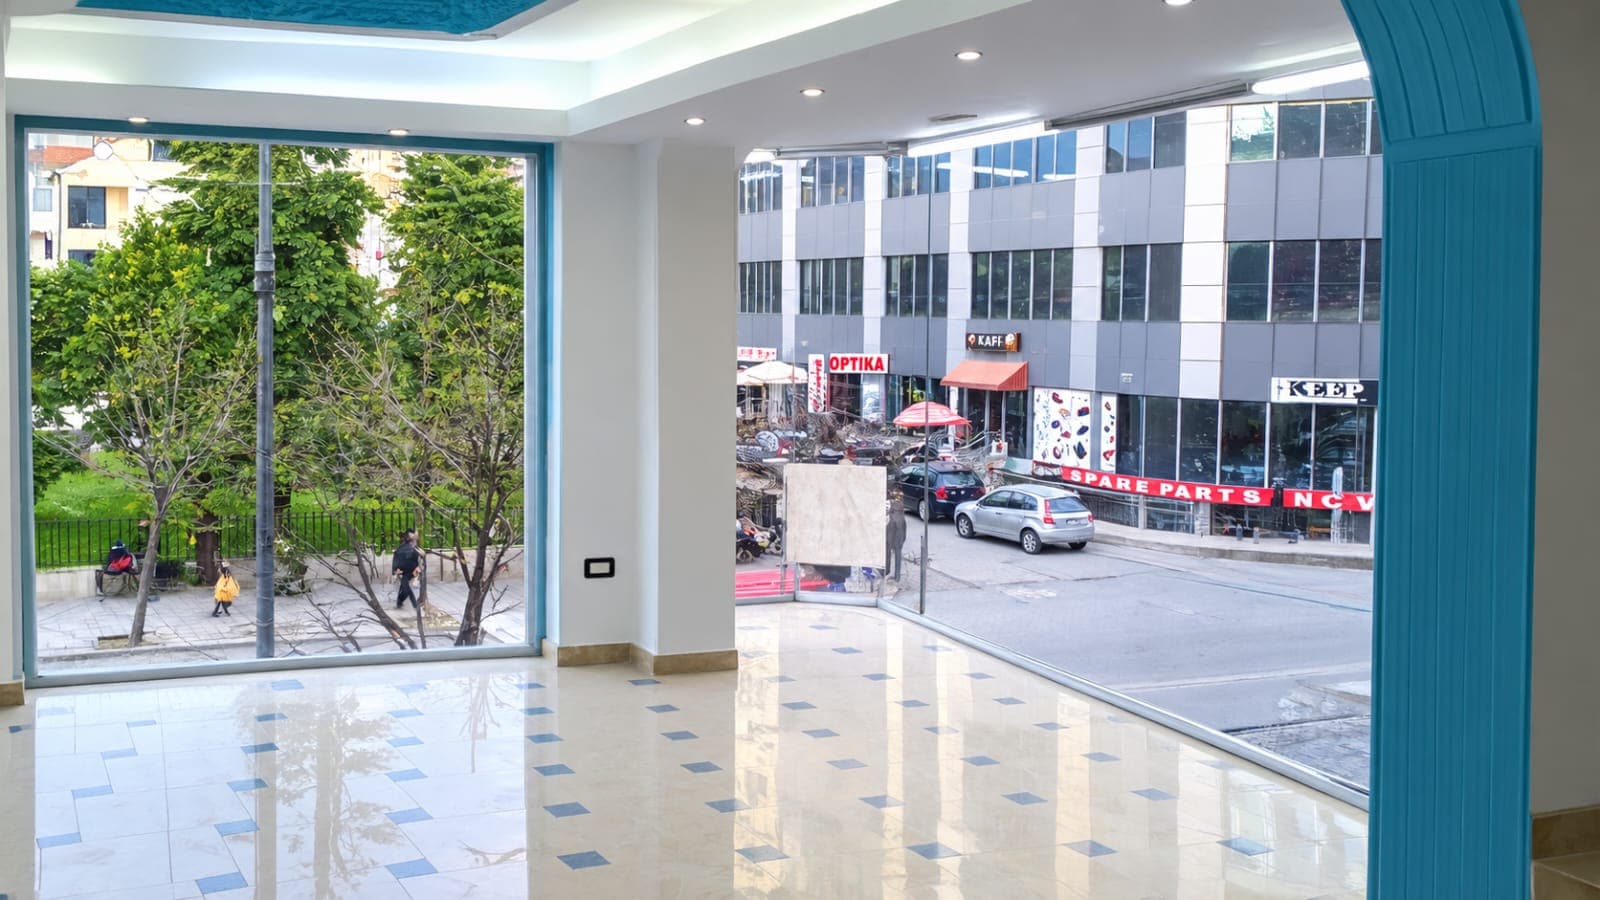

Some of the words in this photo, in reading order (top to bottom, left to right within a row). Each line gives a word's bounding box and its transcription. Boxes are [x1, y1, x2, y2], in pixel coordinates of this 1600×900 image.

[829, 356, 884, 371] OPTIKA
[1288, 380, 1364, 398] KEEP
[1070, 469, 1148, 493] SPARE
[1160, 484, 1261, 503] PARTS
